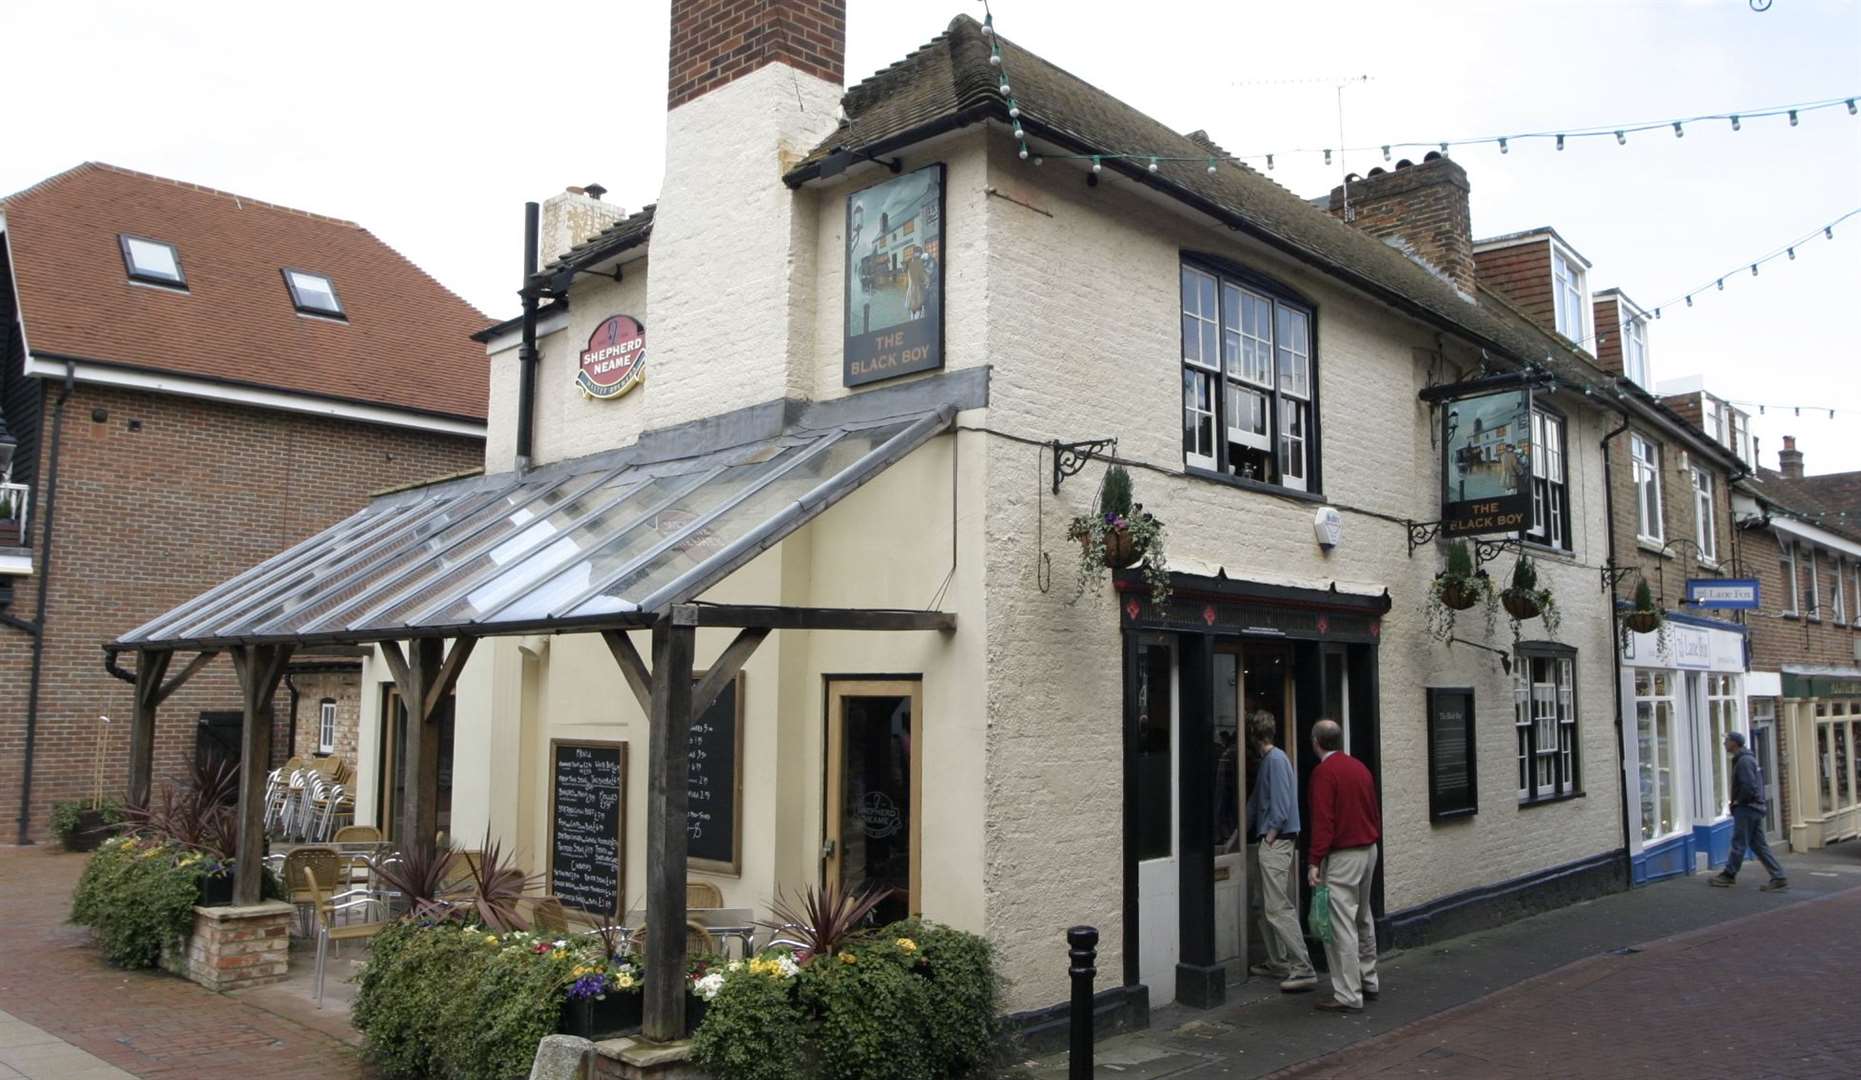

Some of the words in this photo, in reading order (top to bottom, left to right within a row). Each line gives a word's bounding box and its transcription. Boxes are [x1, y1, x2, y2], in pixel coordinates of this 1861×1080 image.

[875, 331, 905, 350] THE
[584, 338, 642, 364] SHEPHERD
[851, 352, 898, 375] BLACK
[902, 344, 930, 363] BOY
[594, 354, 631, 375] NEAME
[1472, 502, 1500, 514] THE
[1449, 517, 1494, 531] BLACK
[1496, 513, 1525, 525] BOY
